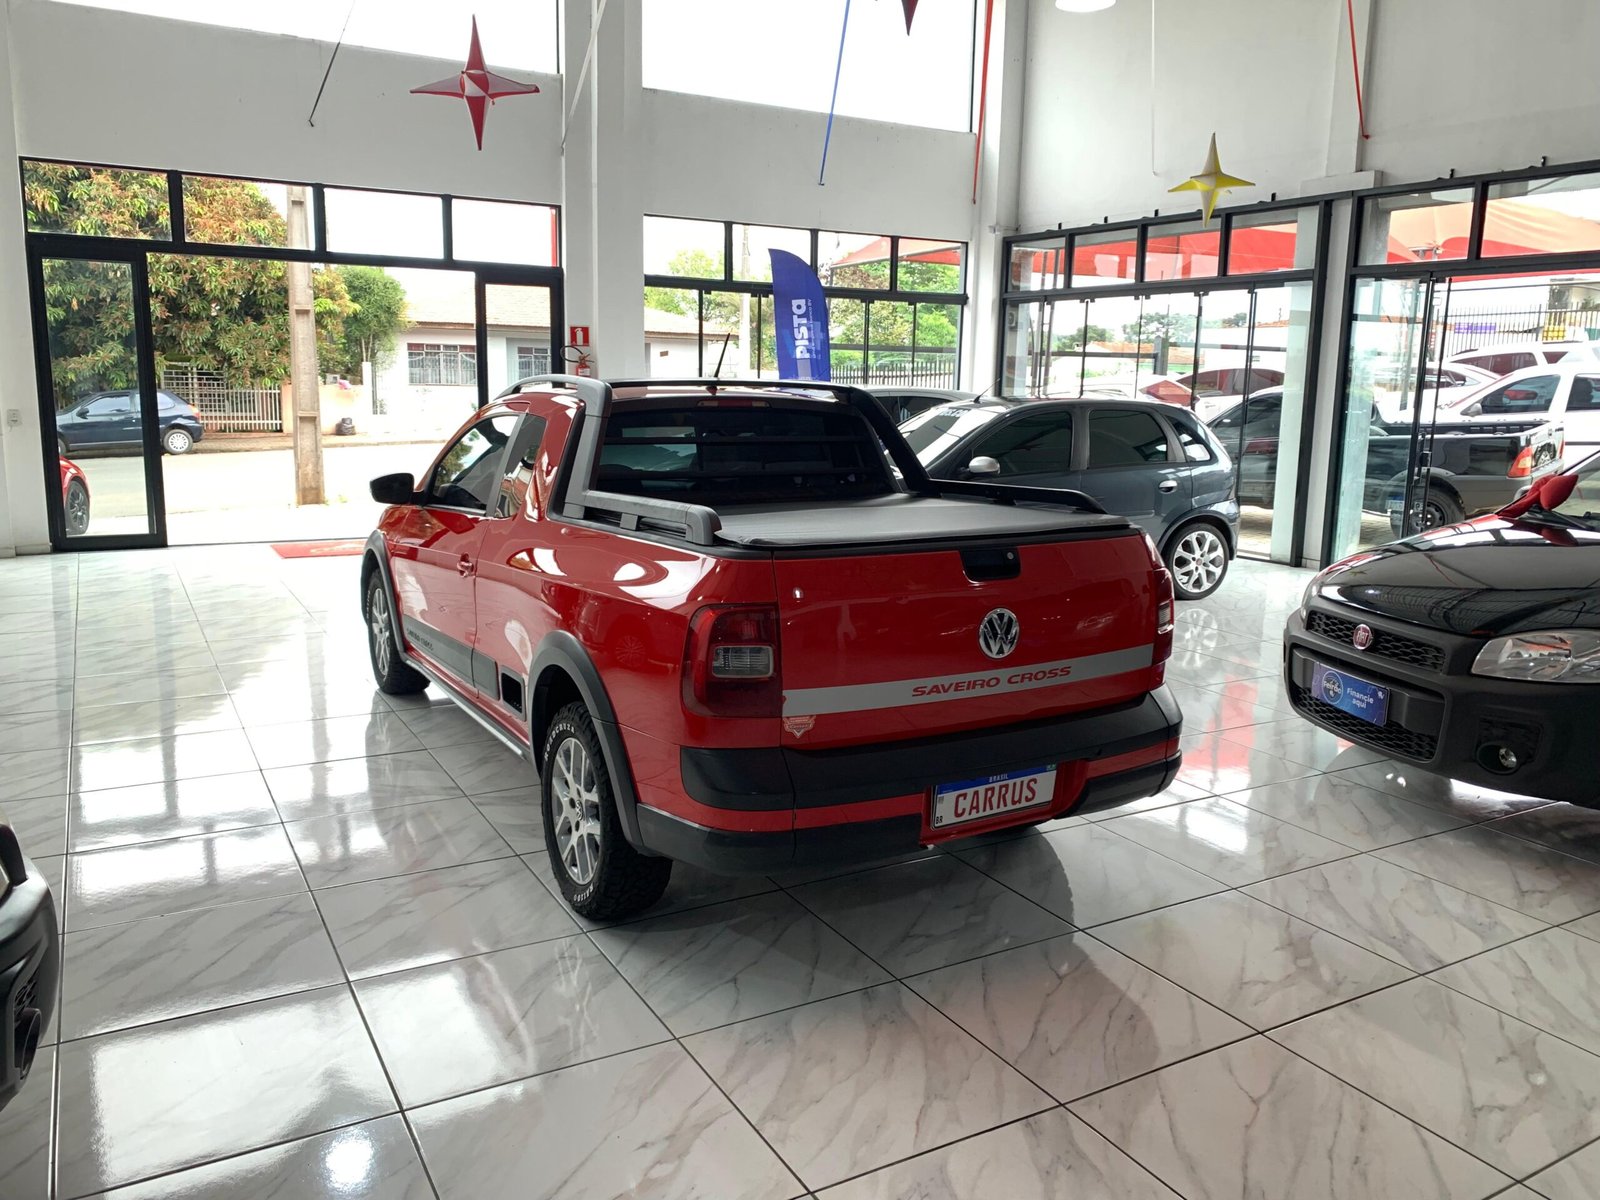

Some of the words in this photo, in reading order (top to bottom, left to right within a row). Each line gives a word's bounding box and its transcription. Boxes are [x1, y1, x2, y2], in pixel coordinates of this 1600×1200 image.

[912, 677, 1001, 697] SAVEIRO
[1007, 666, 1072, 685] CROSS
[1347, 687, 1374, 704] Financie
[1352, 698, 1367, 709] aqui
[989, 773, 1009, 783] BRASIL
[953, 777, 1038, 818] CARRUS
[935, 815, 943, 825] BR
